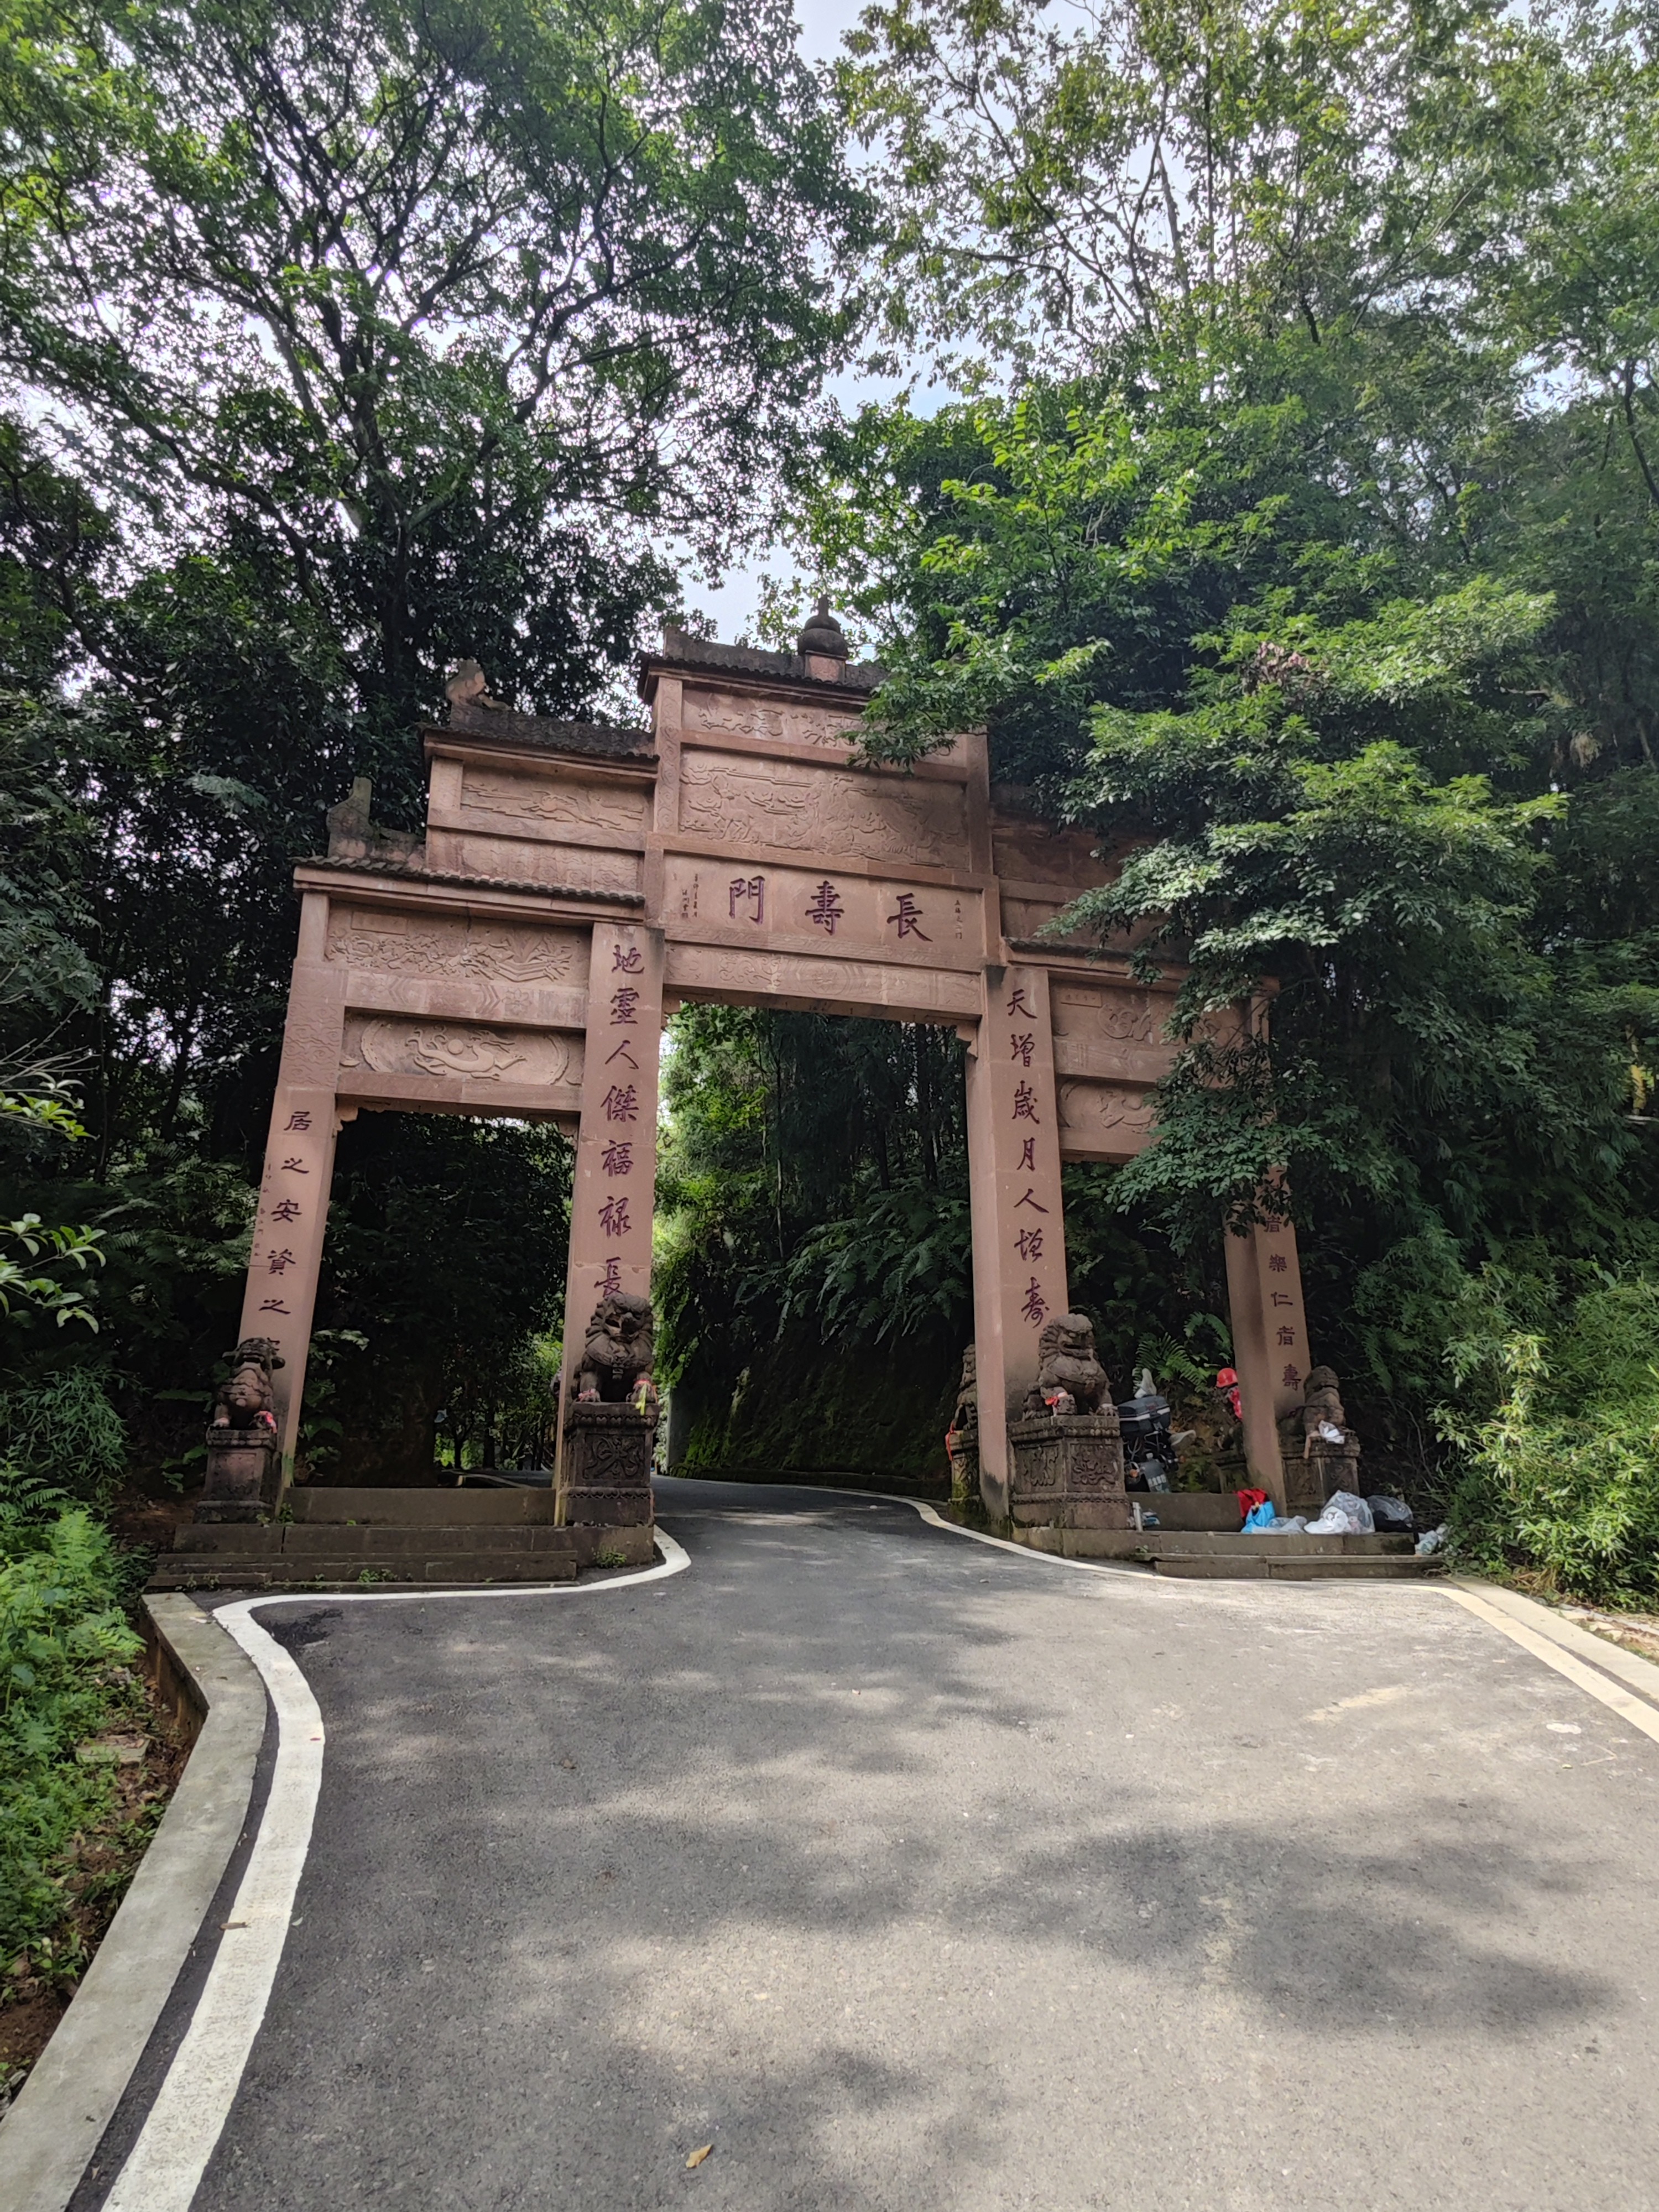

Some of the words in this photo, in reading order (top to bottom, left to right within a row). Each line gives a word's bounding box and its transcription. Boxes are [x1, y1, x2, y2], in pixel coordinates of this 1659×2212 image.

[258, 1111, 313, 1351] 居之安資之
